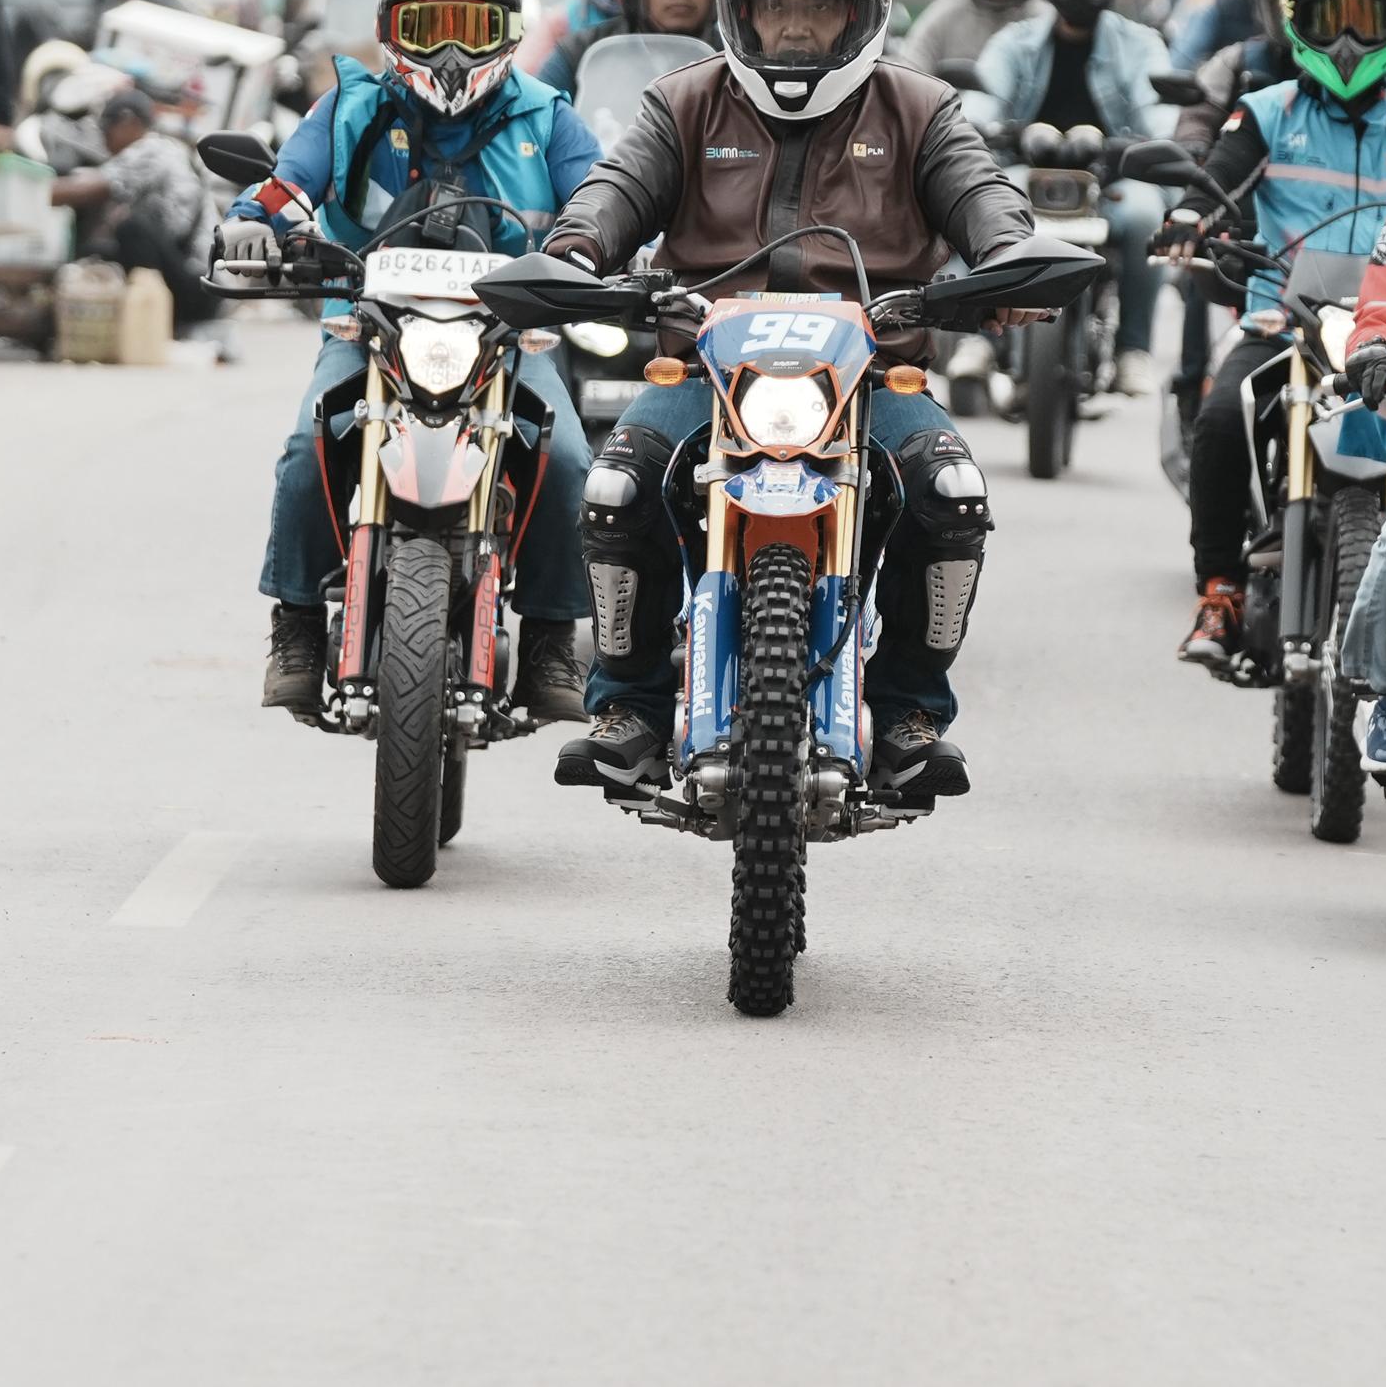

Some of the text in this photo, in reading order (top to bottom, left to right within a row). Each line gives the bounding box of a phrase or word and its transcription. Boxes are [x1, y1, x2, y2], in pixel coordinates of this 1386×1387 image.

[868, 147, 884, 155] PLN
[740, 313, 837, 354] 99
[477, 575, 494, 674] GoPro
[693, 591, 713, 719] Kawasaki
[835, 599, 855, 728] Kawas
